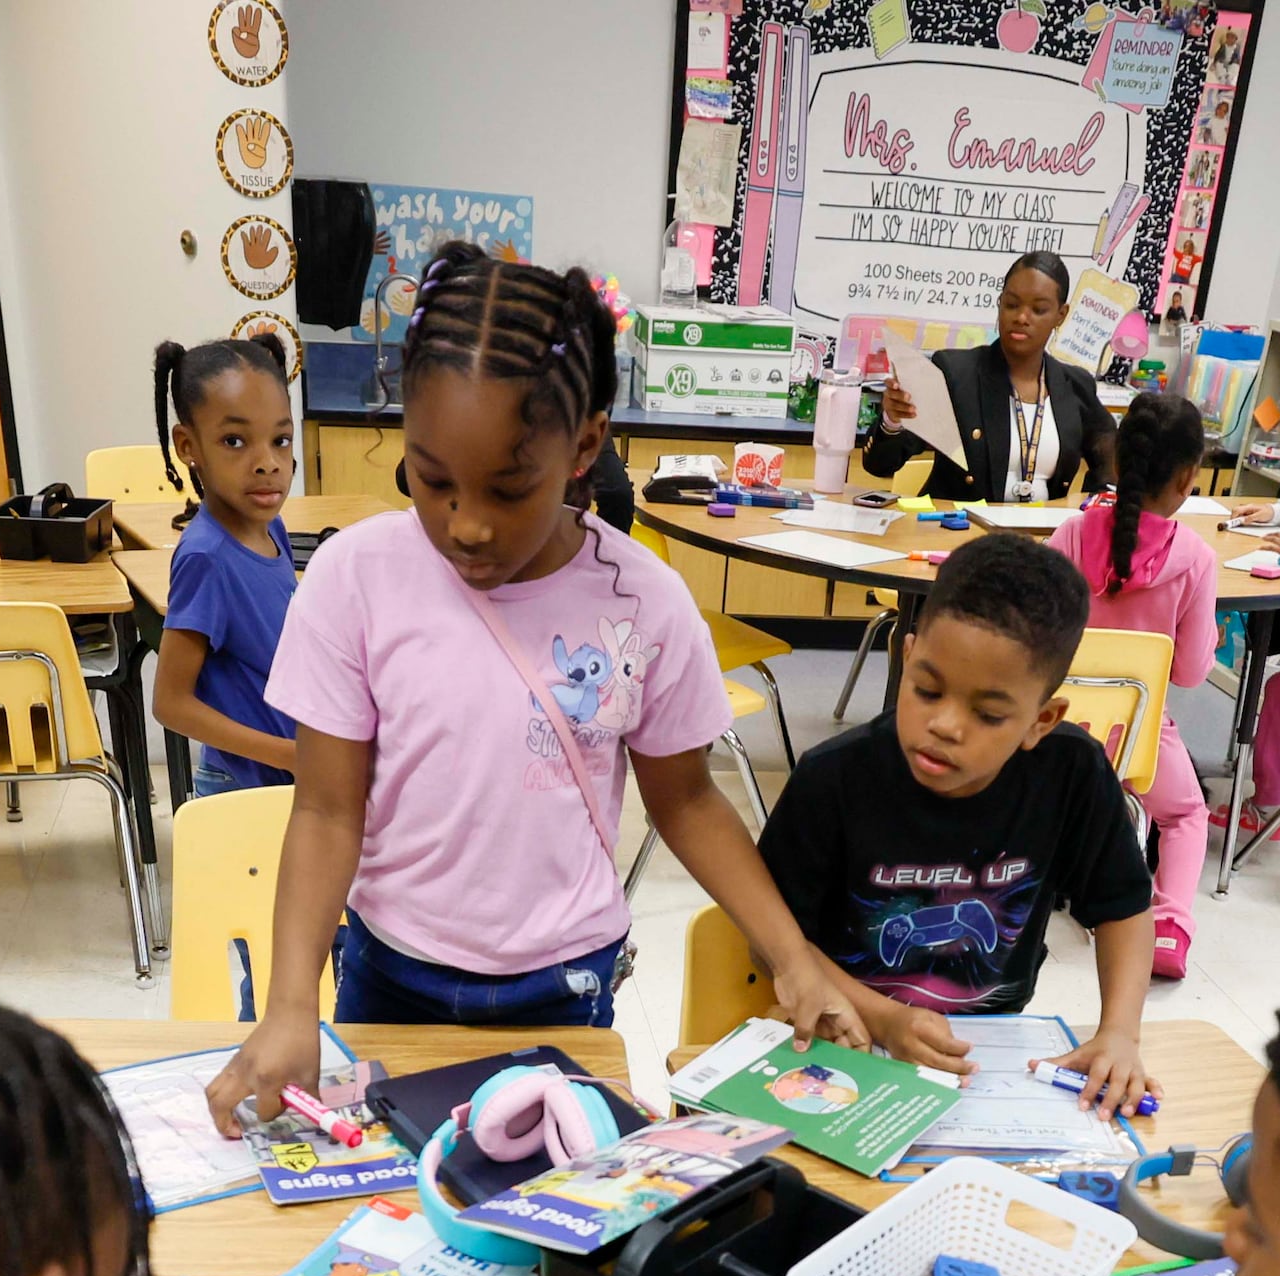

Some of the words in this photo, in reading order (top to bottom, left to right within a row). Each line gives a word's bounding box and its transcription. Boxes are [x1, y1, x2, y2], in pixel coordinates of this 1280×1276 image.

[1114, 39, 1174, 57] REMINDER
[237, 66, 268, 77] WATER
[1137, 61, 1158, 79] doing
[1159, 66, 1170, 74] an
[1113, 79, 1146, 95] amazing
[1146, 80, 1163, 95] job
[844, 91, 918, 175] Mrs.
[948, 106, 1105, 176] Emanuel
[241, 174, 273, 187] TISSUE
[375, 192, 443, 225] wash
[452, 195, 516, 233] your
[872, 181, 944, 214] WELCOME
[955, 189, 974, 216] TO
[981, 191, 1007, 219] MY
[1014, 193, 1056, 222] CLASS
[852, 212, 873, 240] I'M
[881, 214, 903, 241] SO
[910, 218, 959, 249] HAPPY
[969, 222, 1019, 252] YOU'RE
[1026, 228, 1063, 251] HERE!
[240, 281, 281, 291] QUESTION
[864, 264, 891, 278] 100
[895, 265, 942, 284] Sheets
[947, 271, 974, 286] 200
[979, 273, 1004, 291] Pag
[928, 289, 958, 305] 24.7
[962, 295, 969, 307] x
[974, 294, 997, 307] 19.
[1081, 295, 1119, 320] REMINDER
[670, 368, 692, 393] X9
[526, 718, 612, 758] STICH
[874, 866, 972, 885] LEVEL
[987, 861, 1028, 884] UP
[278, 1173, 355, 1190] Signs
[531, 1207, 602, 1237] Road
